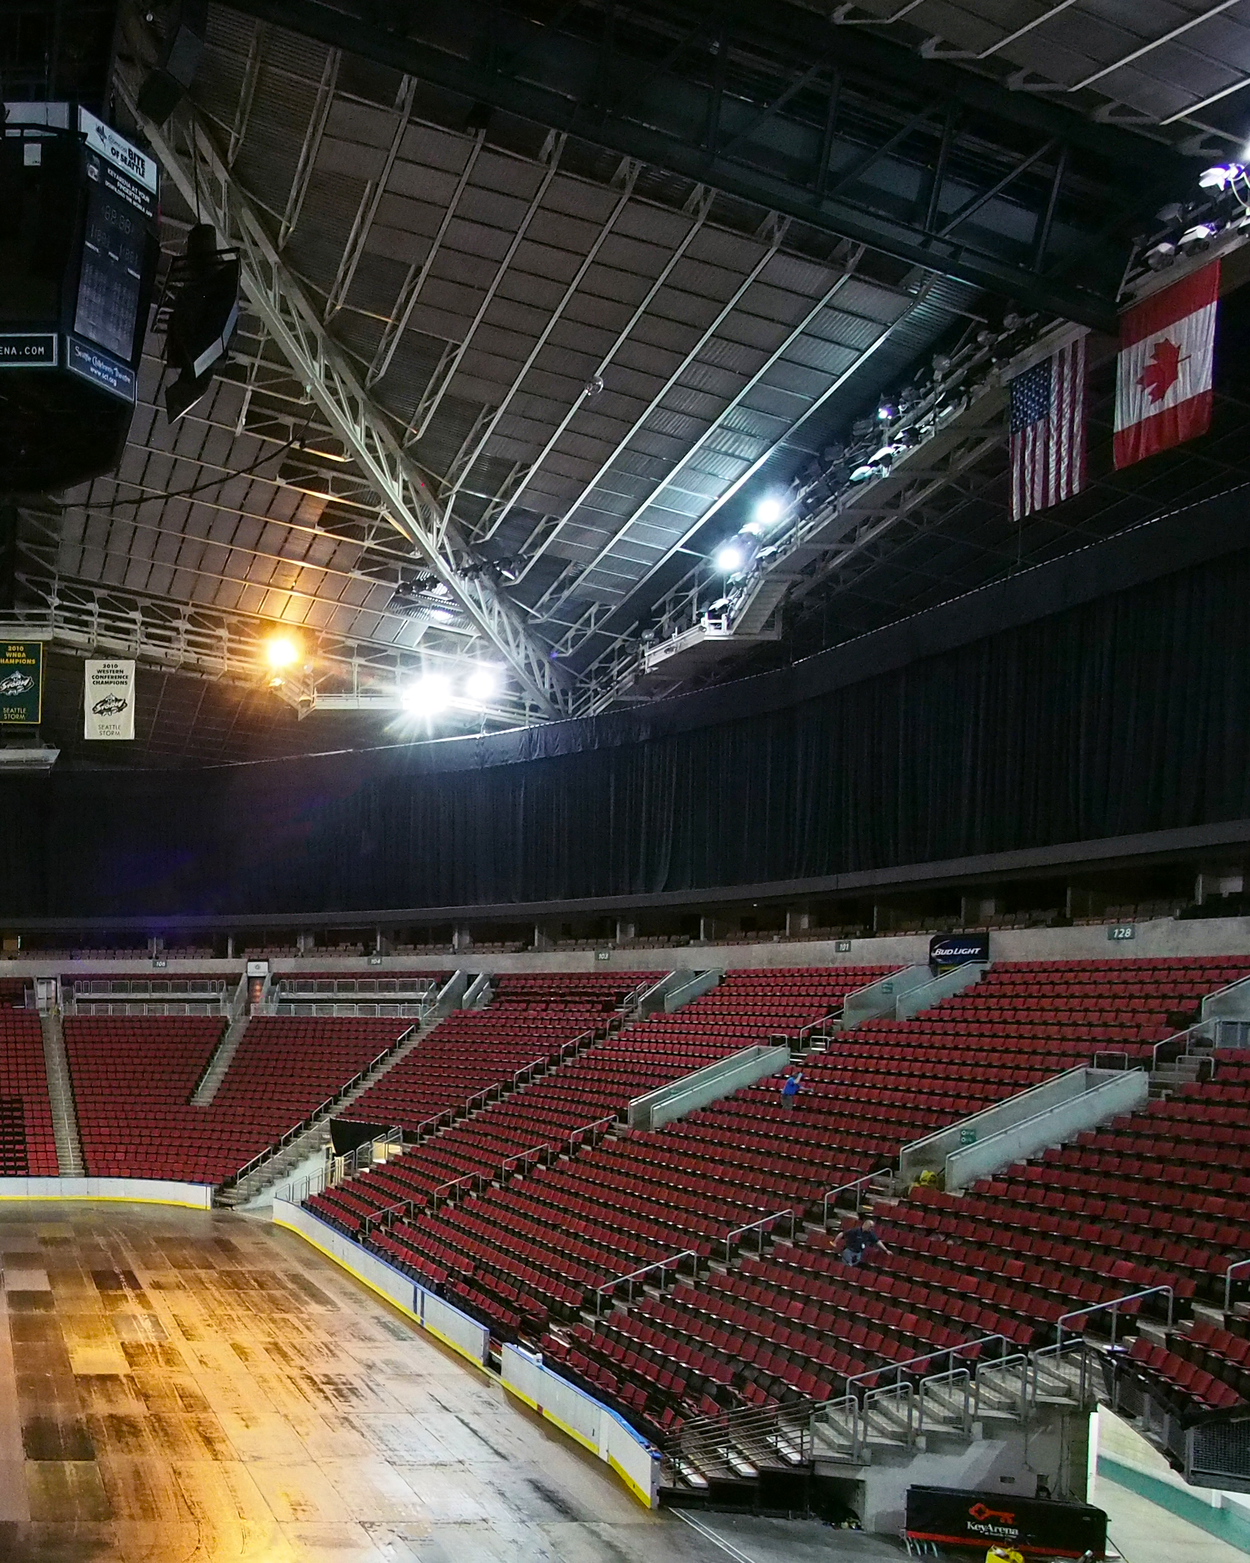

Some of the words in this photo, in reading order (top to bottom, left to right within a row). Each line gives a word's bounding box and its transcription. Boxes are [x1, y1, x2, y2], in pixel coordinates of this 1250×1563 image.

[111, 147, 120, 160] OF
[119, 153, 145, 179] SEATTLE
[128, 148, 145, 169] BITE
[116, 181, 141, 204] FINGERTIPS
[138, 188, 150, 204] YOUR
[1113, 928, 1132, 938] 128
[839, 943, 849, 951] 101
[934, 948, 954, 956] BUD
[953, 947, 982, 955] LIGHT
[966, 1521, 1019, 1536] KeyArena
